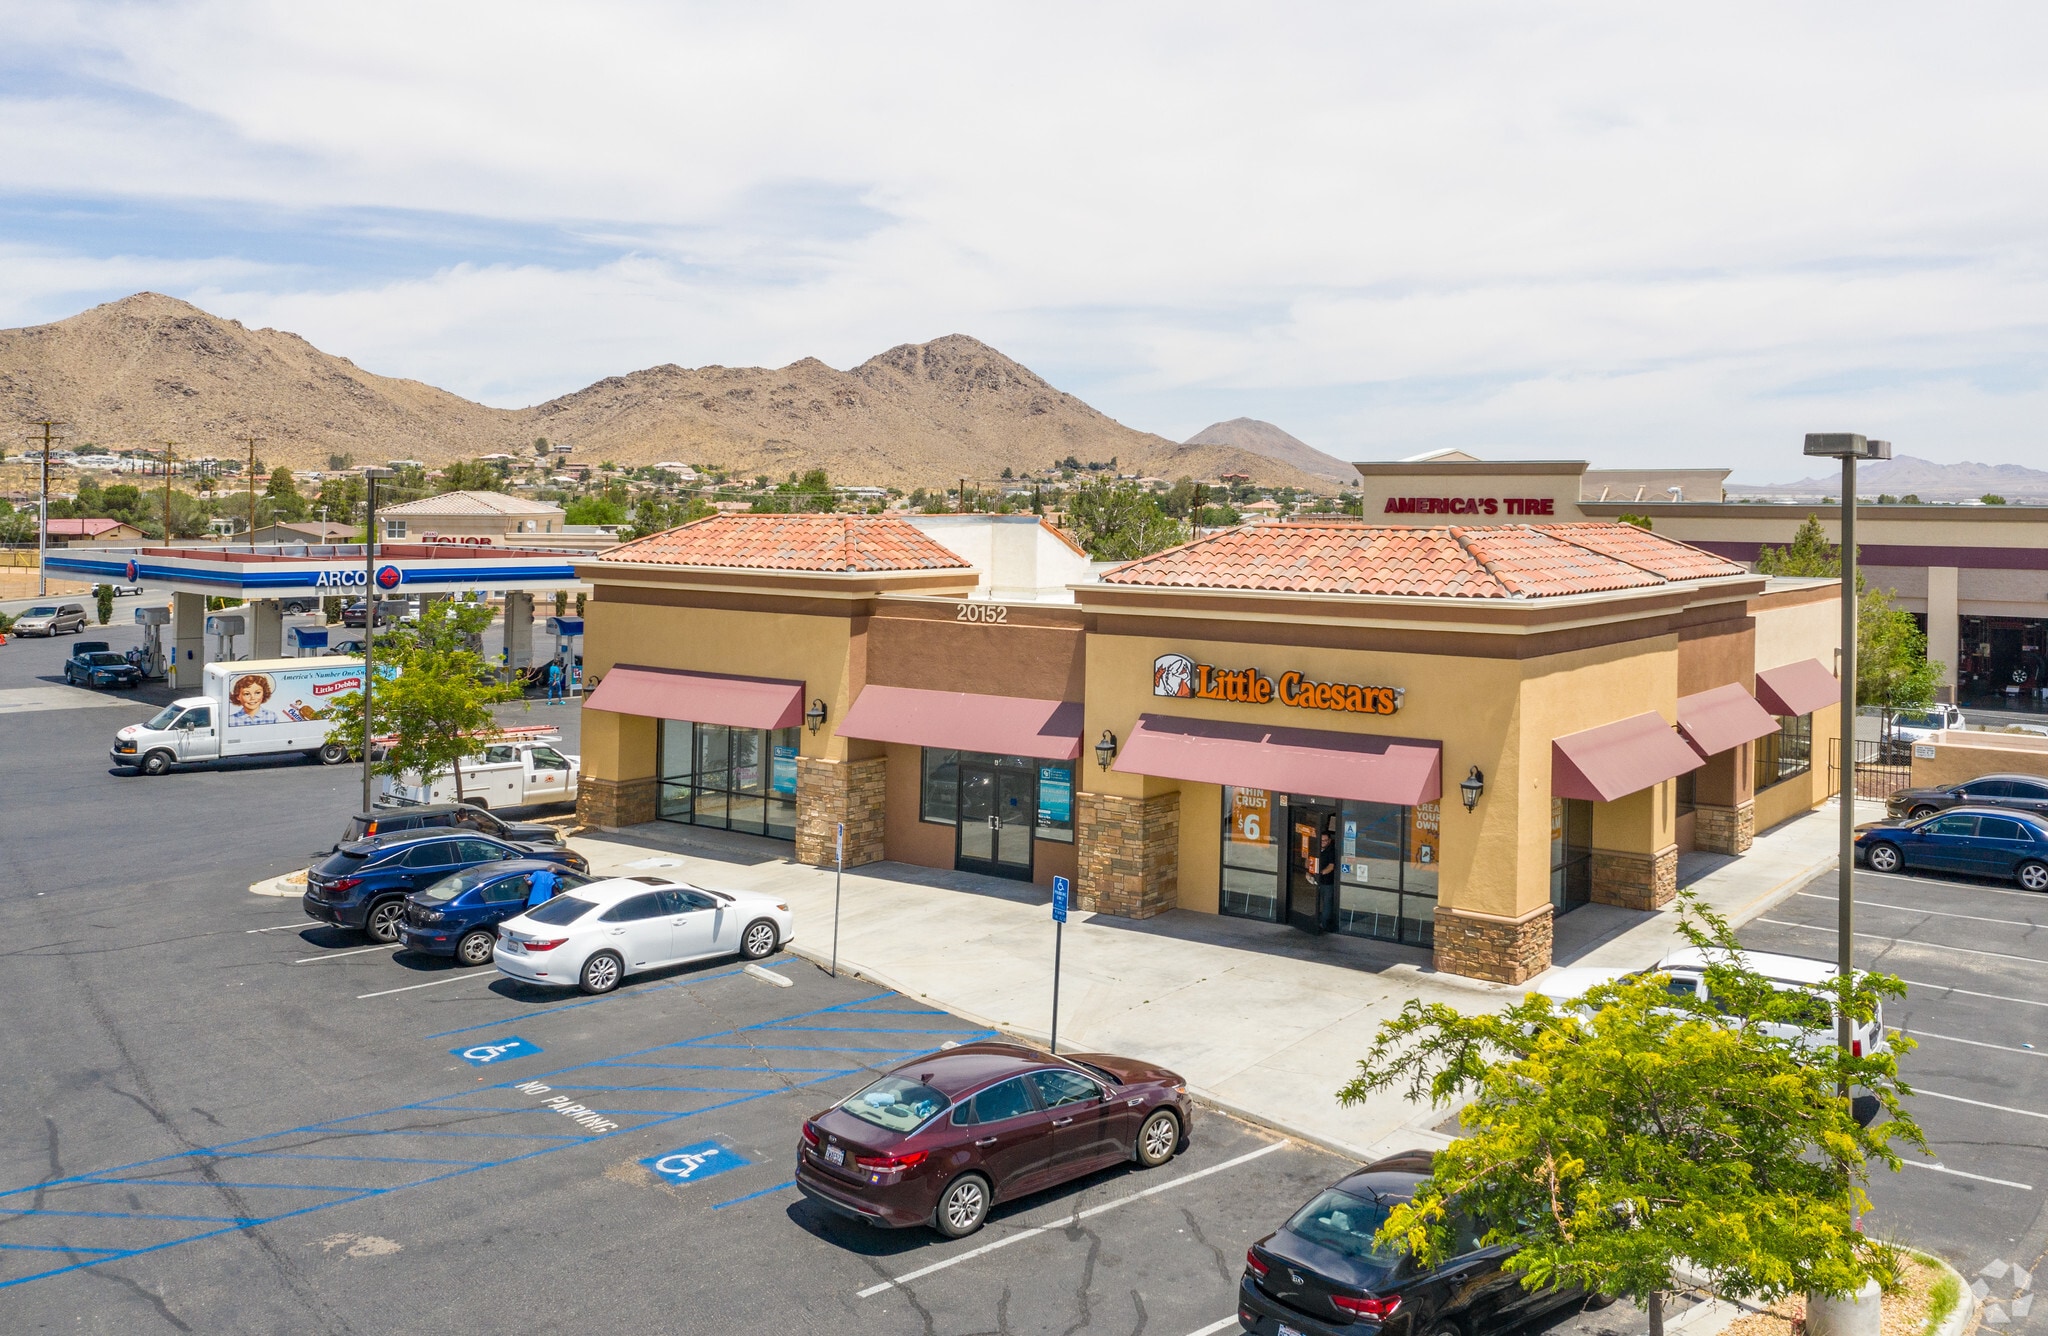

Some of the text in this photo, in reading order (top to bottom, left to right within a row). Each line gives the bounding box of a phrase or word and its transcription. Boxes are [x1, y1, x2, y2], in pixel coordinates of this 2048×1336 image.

[1384, 497, 1555, 515] AMERICA'S TIRE
[316, 570, 368, 587] ARCO
[957, 604, 1008, 624] 20152
[281, 673, 314, 681] America's
[315, 680, 359, 695] Little Debbie
[1196, 663, 1399, 715] Little Caesars
[1236, 796, 1268, 808] CRUST
[1416, 811, 1440, 822] YOUR
[1237, 813, 1261, 841] $6
[1416, 820, 1438, 831] OWN
[514, 1080, 619, 1133] NO PARKING
